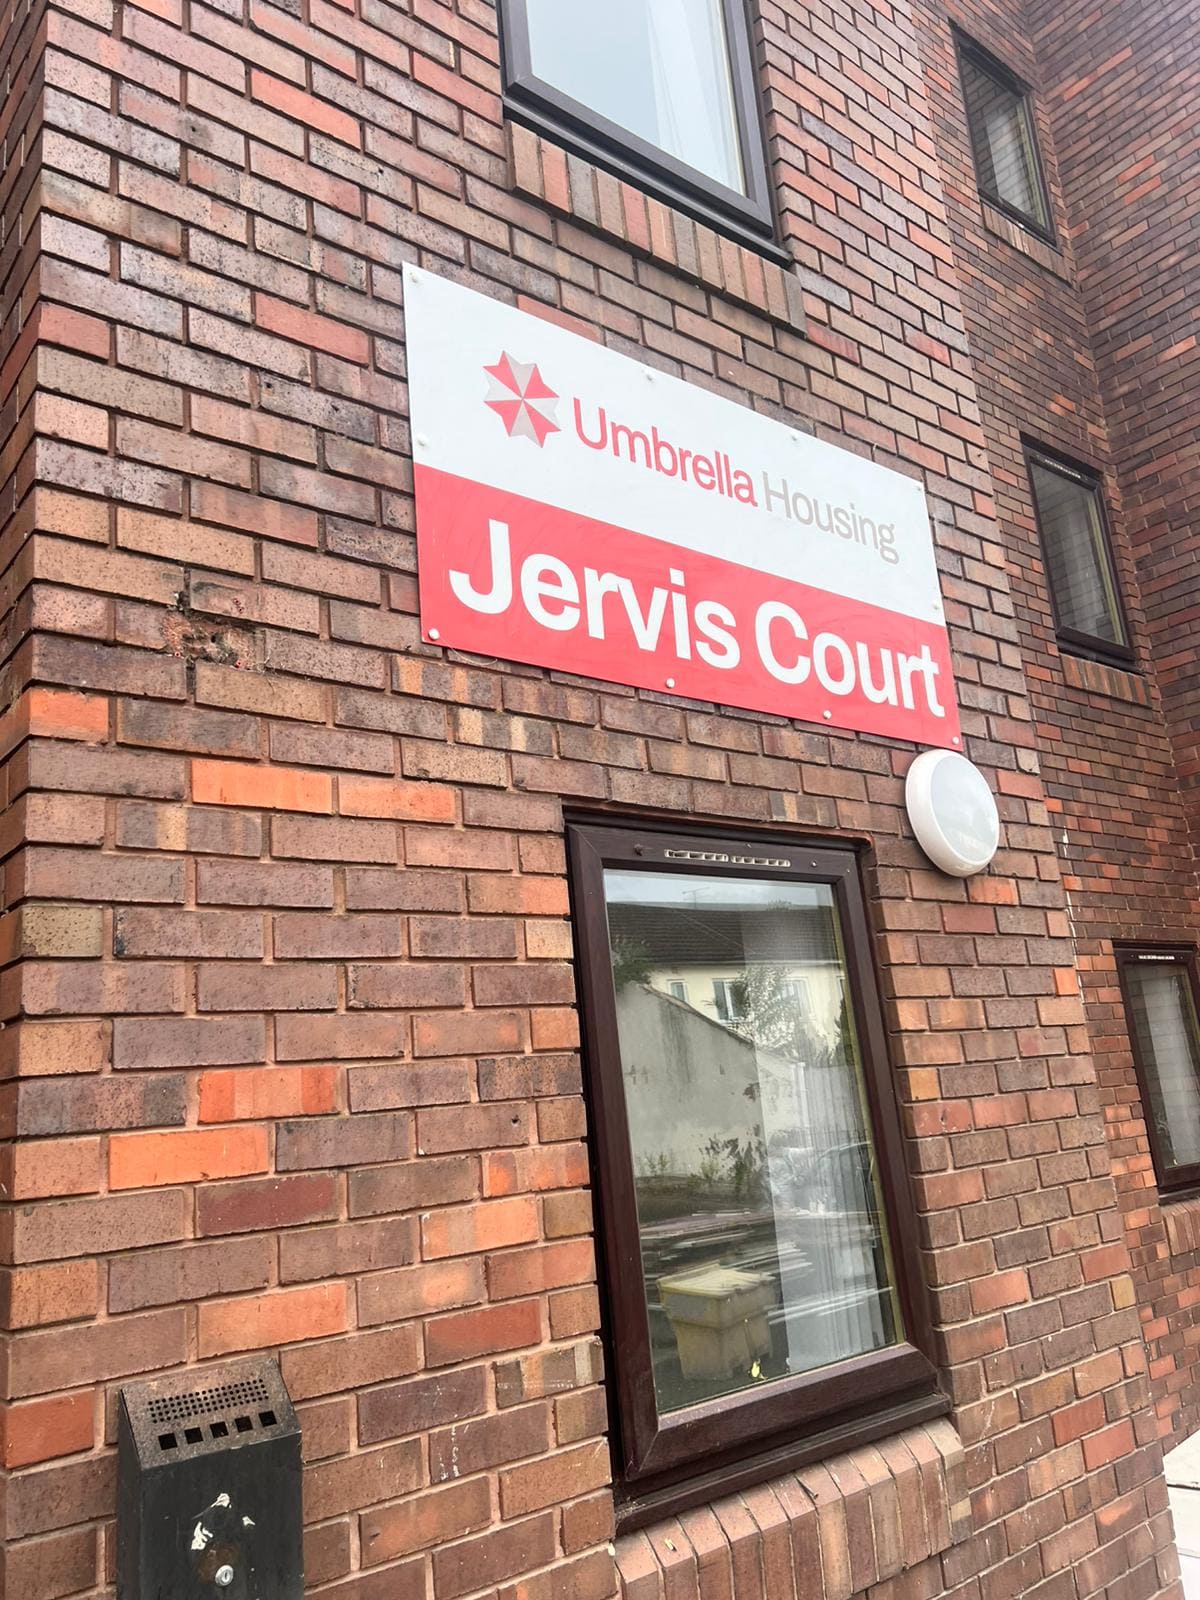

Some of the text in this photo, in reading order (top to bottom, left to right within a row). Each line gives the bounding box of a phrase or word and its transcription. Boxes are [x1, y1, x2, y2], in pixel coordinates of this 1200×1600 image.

[573, 397, 900, 565] Umbrella Housing
[449, 519, 945, 718] Jervis Court
